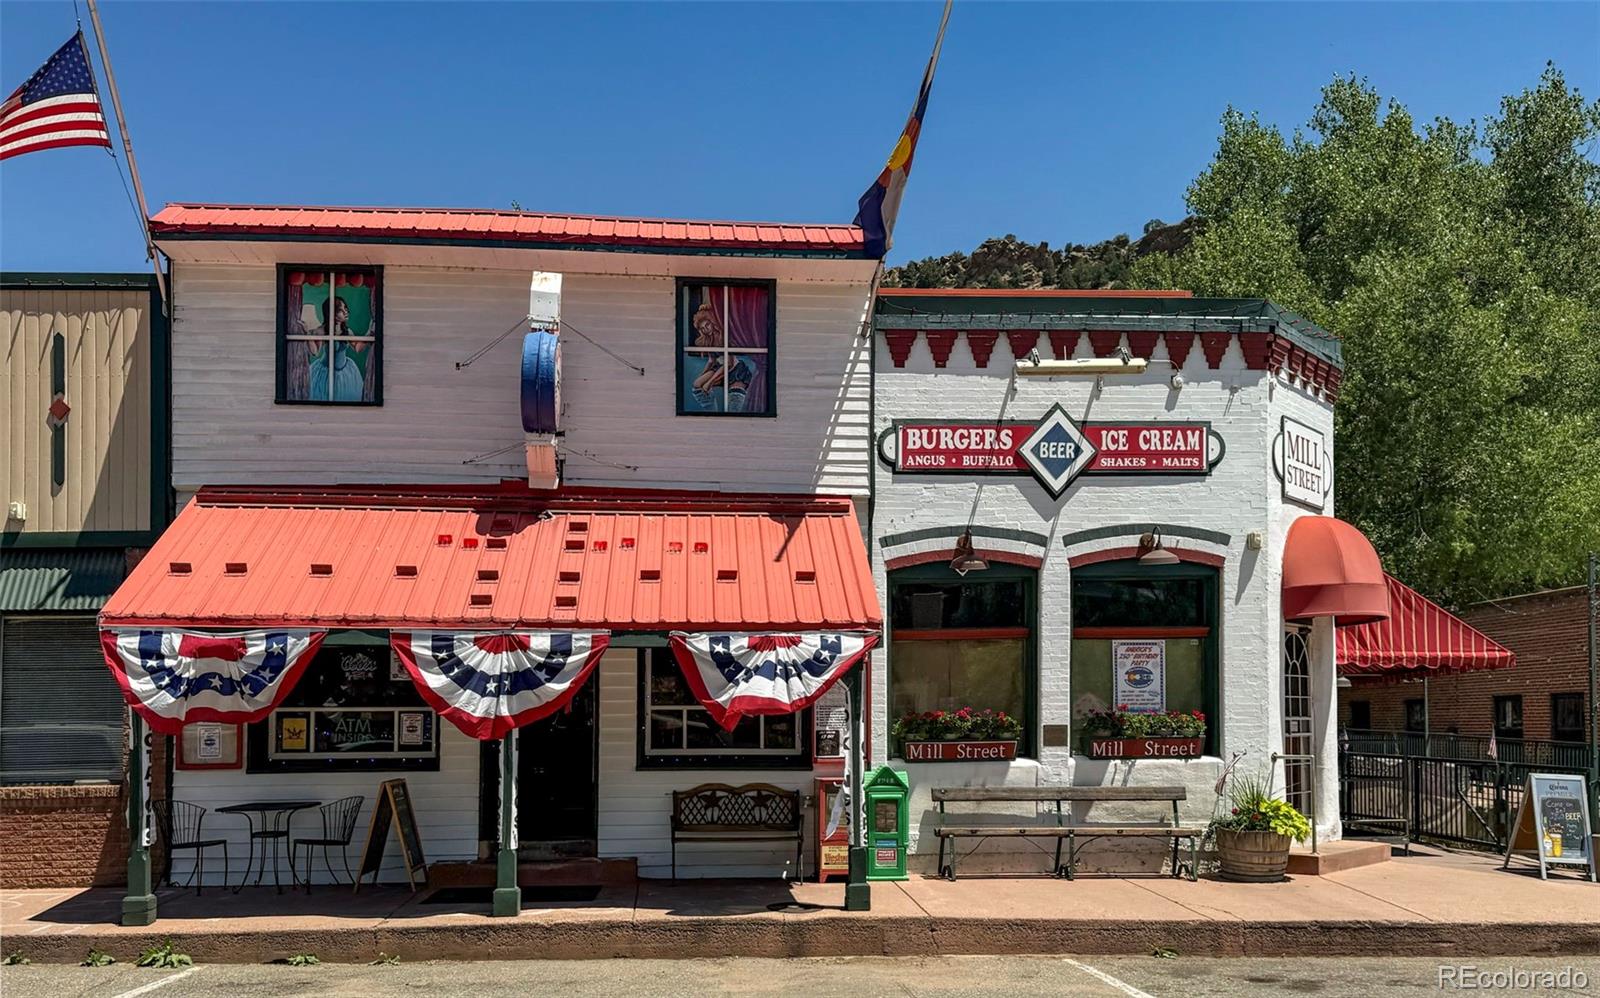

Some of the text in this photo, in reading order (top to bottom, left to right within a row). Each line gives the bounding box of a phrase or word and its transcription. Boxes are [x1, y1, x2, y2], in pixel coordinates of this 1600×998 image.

[906, 428, 1013, 450] BURGERS
[1100, 430, 1200, 451] ICE CREAM
[1039, 442, 1075, 459] BEER
[1286, 431, 1321, 470] MILL
[906, 455, 1014, 466] ANGUS BUFFALO
[1100, 457, 1200, 467] SHAKES MALTS
[1286, 464, 1322, 494] STREET
[335, 718, 372, 733] ATM
[909, 743, 1006, 760] Mill Street
[1092, 740, 1197, 757] Mill Street
[1565, 812, 1582, 821] BEER
